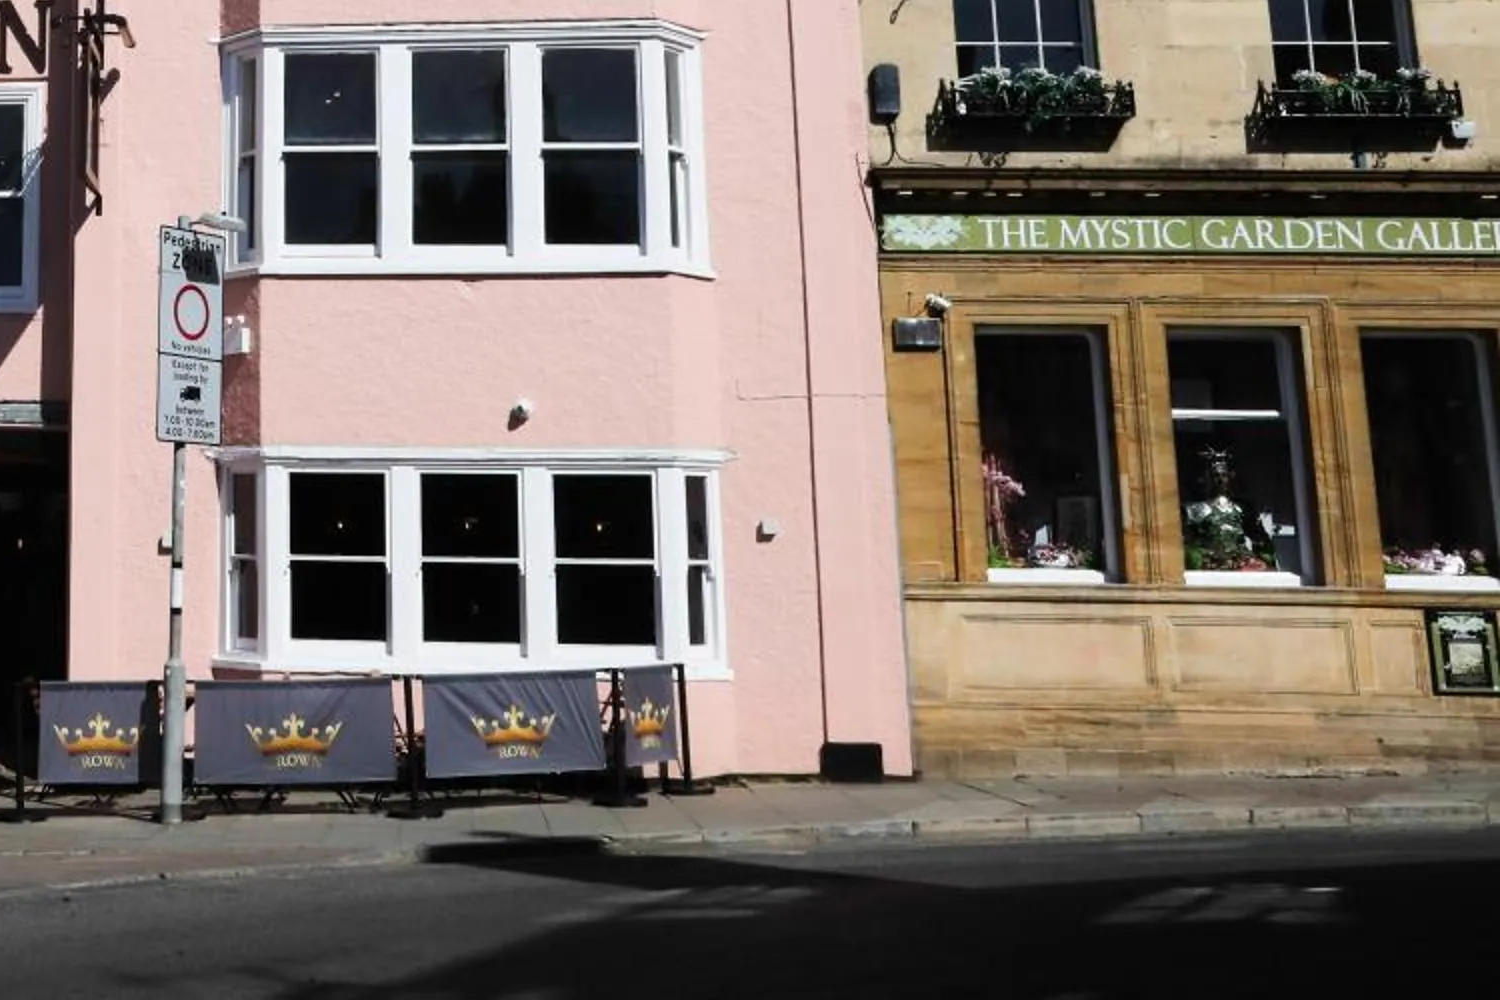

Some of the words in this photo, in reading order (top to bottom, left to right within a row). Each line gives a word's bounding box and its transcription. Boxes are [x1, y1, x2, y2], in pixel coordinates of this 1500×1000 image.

[978, 218, 1049, 249] THE
[1059, 218, 1193, 249] MYSTIC
[1201, 218, 1364, 250] GARDEN
